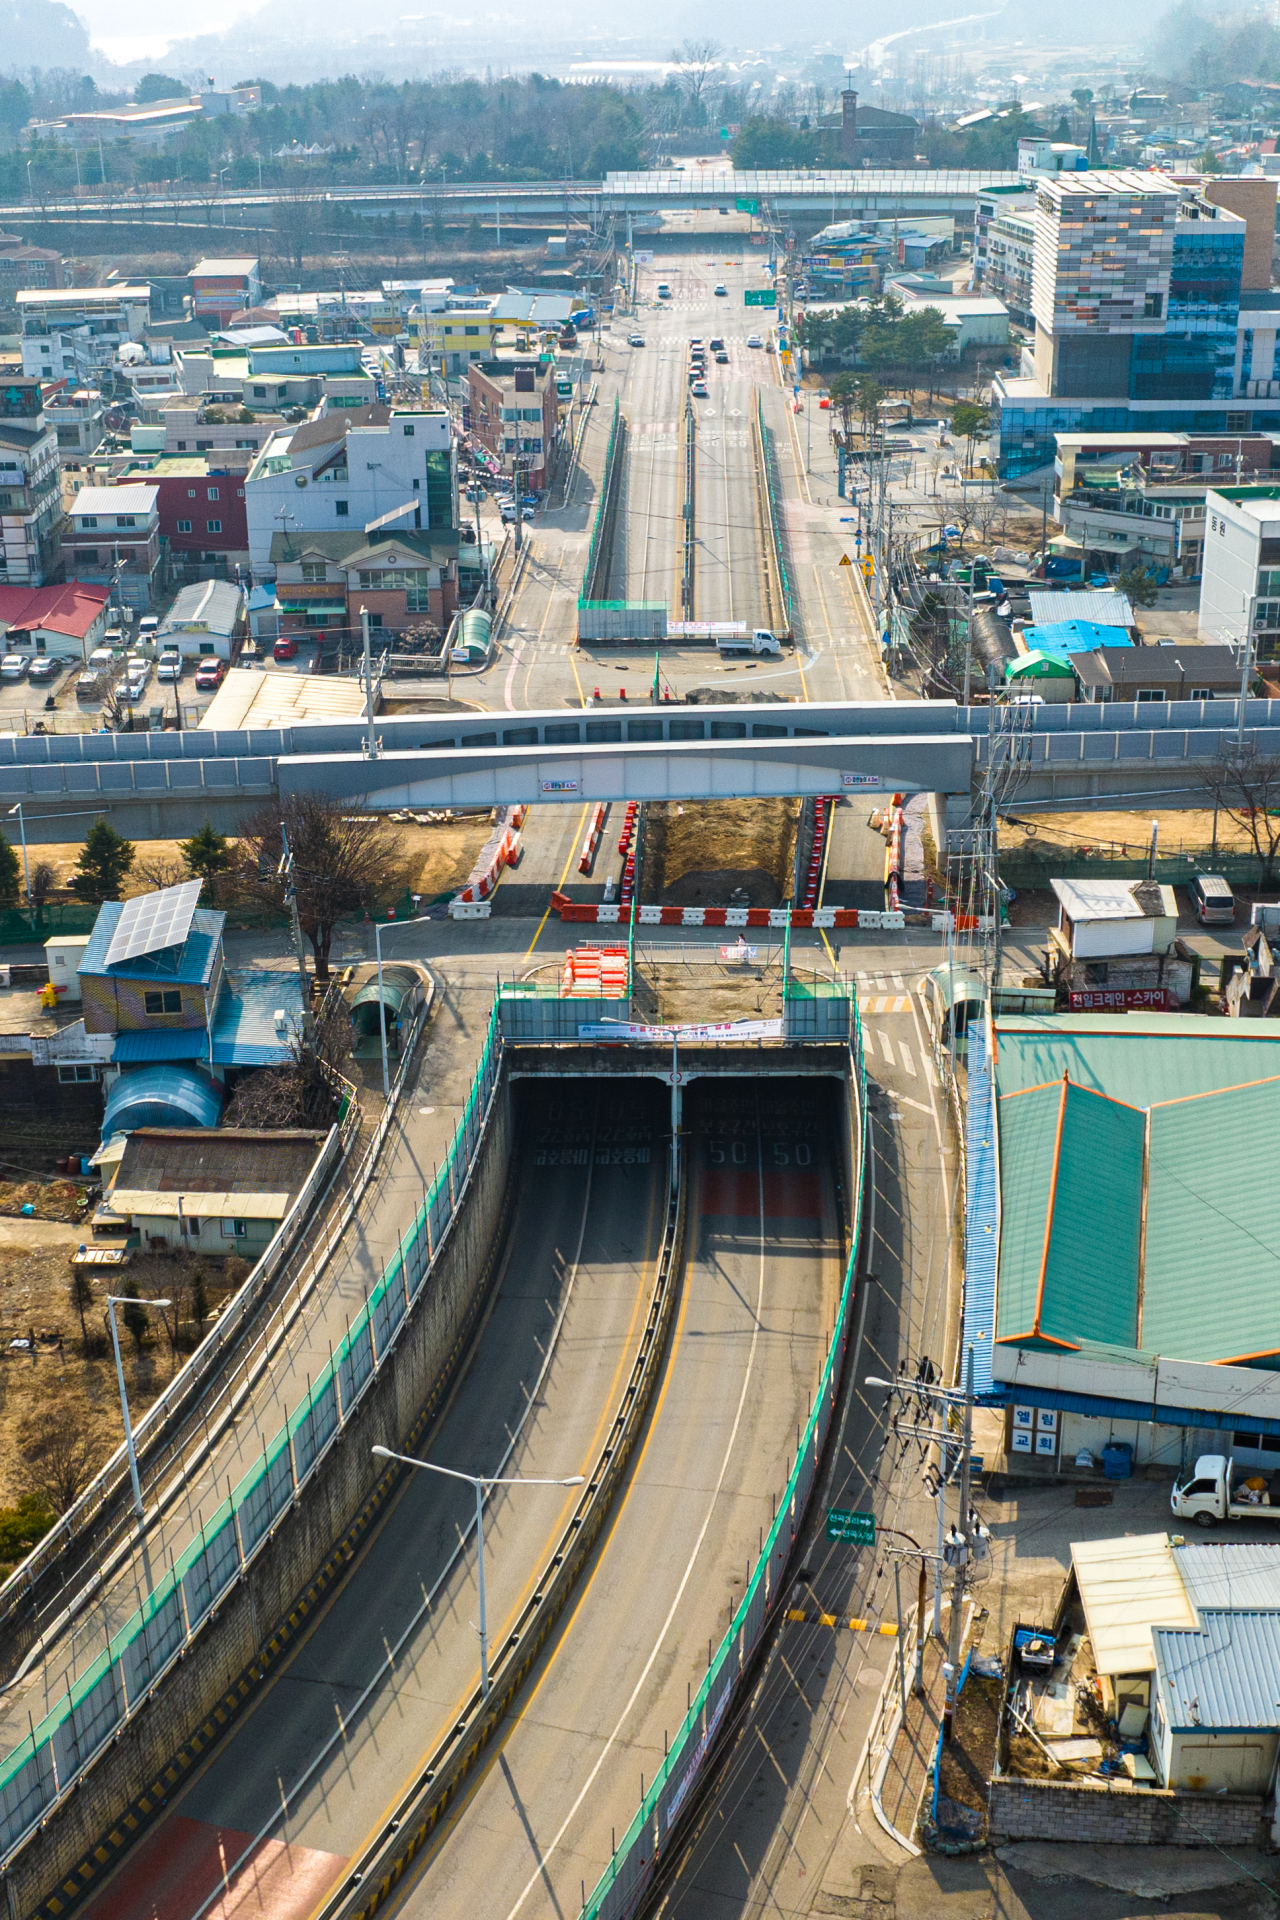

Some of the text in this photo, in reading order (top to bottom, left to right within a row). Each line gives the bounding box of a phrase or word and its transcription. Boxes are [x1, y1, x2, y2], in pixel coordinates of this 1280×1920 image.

[534, 1148, 588, 1165] 마을주민
[595, 1147, 651, 1165] 마을주민
[709, 1140, 747, 1164] 50
[773, 1142, 811, 1166] 50
[1016, 1410, 1053, 1426] 엘림
[1015, 1434, 1052, 1450] 교회
